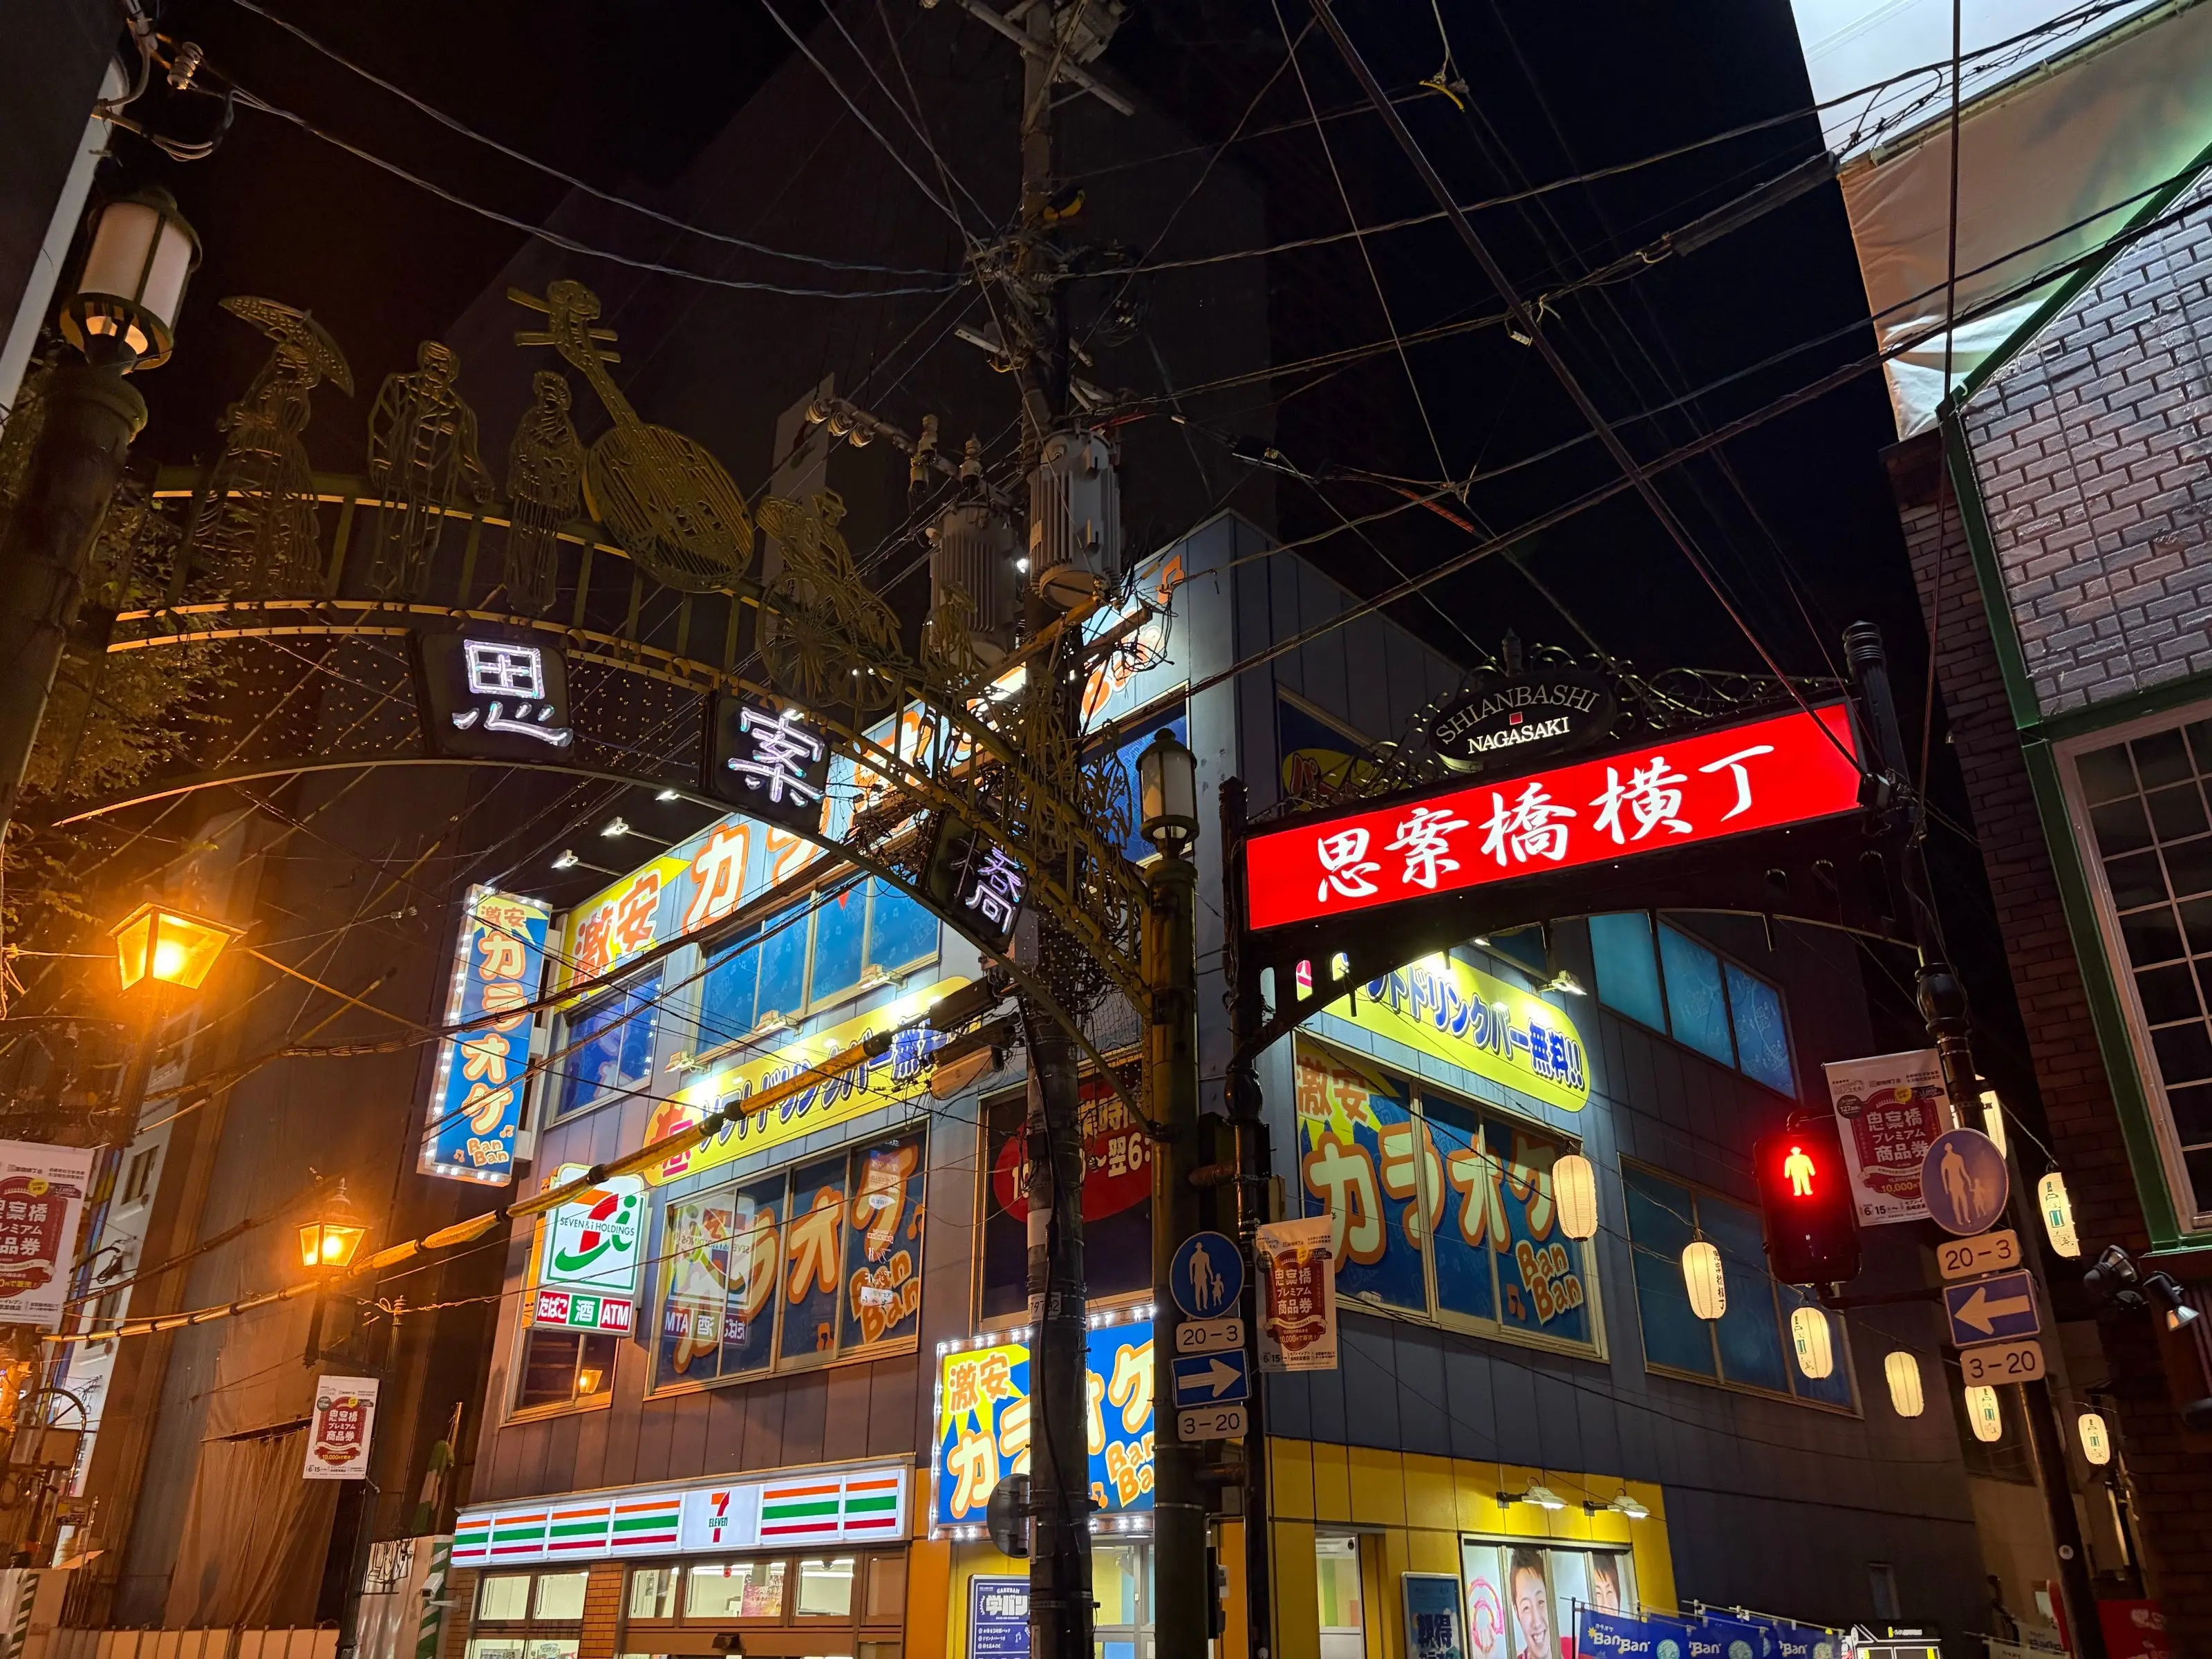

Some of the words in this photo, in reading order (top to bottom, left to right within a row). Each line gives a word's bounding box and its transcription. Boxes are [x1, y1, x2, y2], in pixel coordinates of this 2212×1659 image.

[453, 639, 573, 747] 思
[727, 706, 826, 806] 案
[1436, 684, 1600, 746] SHIANBASHI
[1468, 716, 1571, 754] NAGASAKI
[1318, 745, 1775, 902] 思案橋横丁
[480, 906, 525, 928] 激安
[572, 867, 662, 988] 激安
[462, 930, 528, 1135] カラオケ
[1297, 1055, 1369, 1123] 激安
[1866, 1107, 1922, 1132] 思案橋
[467, 1137, 503, 1156] Ban
[1873, 1131, 1926, 1144] プレミアム
[473, 1149, 509, 1167] Ban
[1874, 1141, 1929, 1163] 商品券
[1303, 1121, 1556, 1271] カラオケ
[595, 1223, 635, 1236] HOLDINGS
[1275, 1266, 1312, 1286] 思案橋
[1516, 1238, 1569, 1292] Ban
[1277, 1287, 1311, 1297] プレミアム
[1533, 1273, 1582, 1325] Ban
[538, 1295, 568, 1319] たばこ
[574, 1300, 595, 1322] 酒
[601, 1304, 630, 1327] ATM
[1277, 1297, 1313, 1315] 商品券
[949, 1353, 1010, 1412] 激安
[1117, 1464, 1154, 1508] Ba
[986, 1595, 1028, 1616] 学バン
